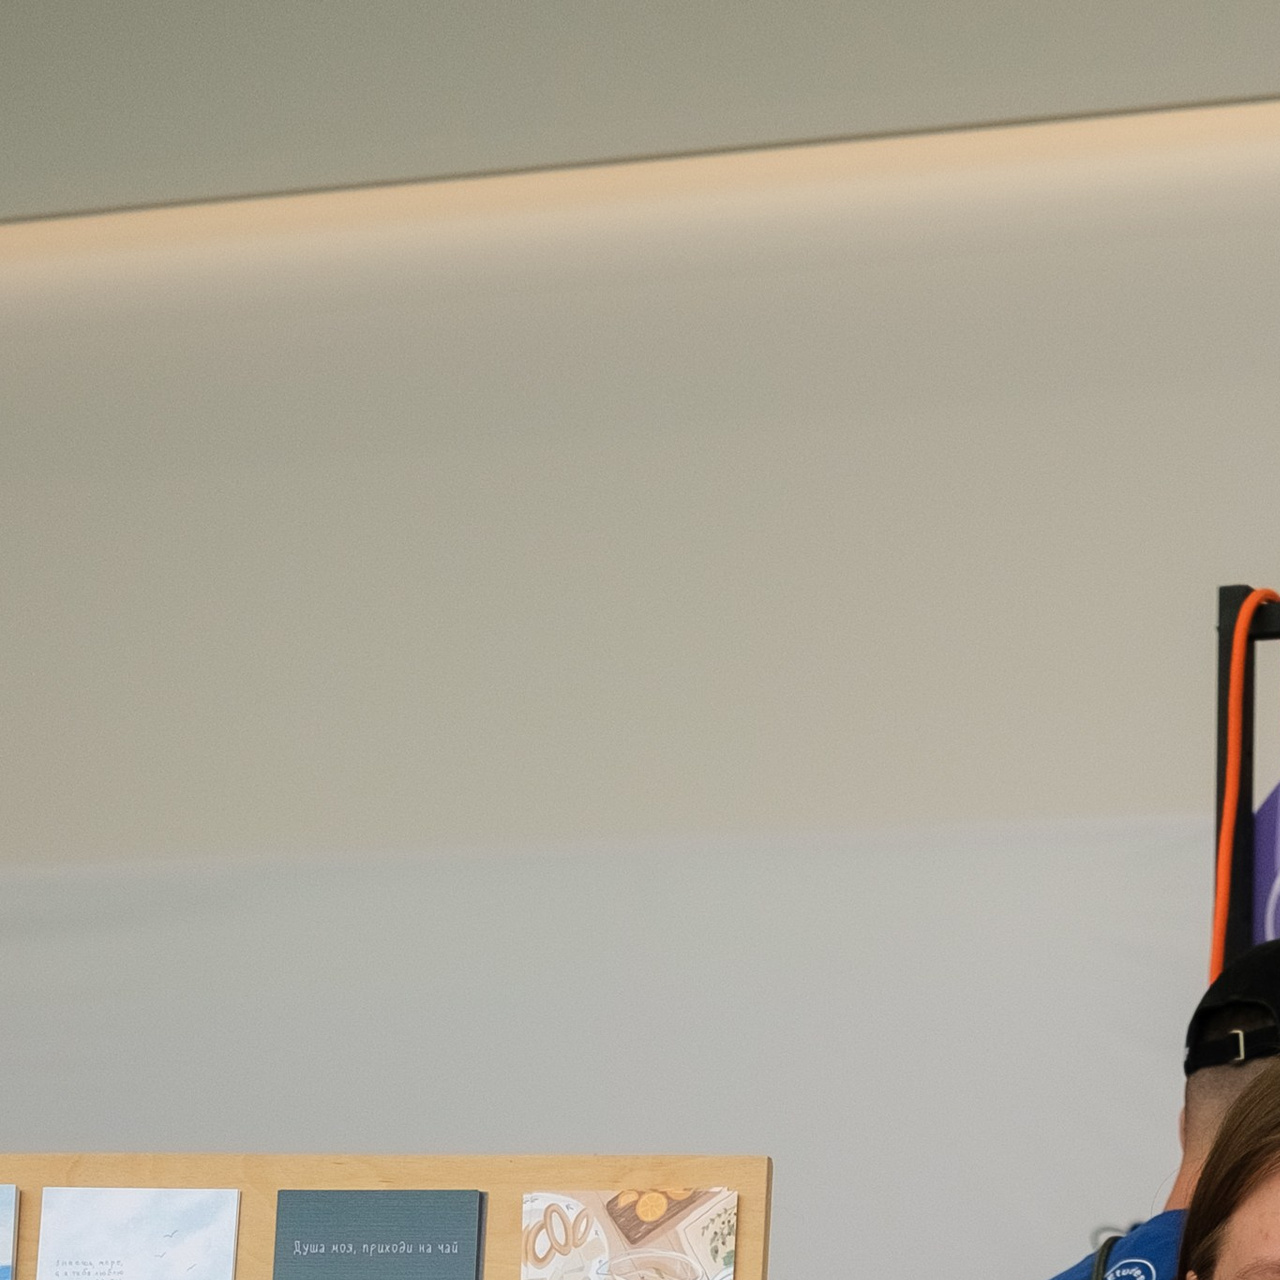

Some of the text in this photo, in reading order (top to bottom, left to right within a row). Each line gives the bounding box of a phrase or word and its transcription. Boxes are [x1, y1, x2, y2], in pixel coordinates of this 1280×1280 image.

[293, 1240, 458, 1257] Душа моя, приходи на чай
